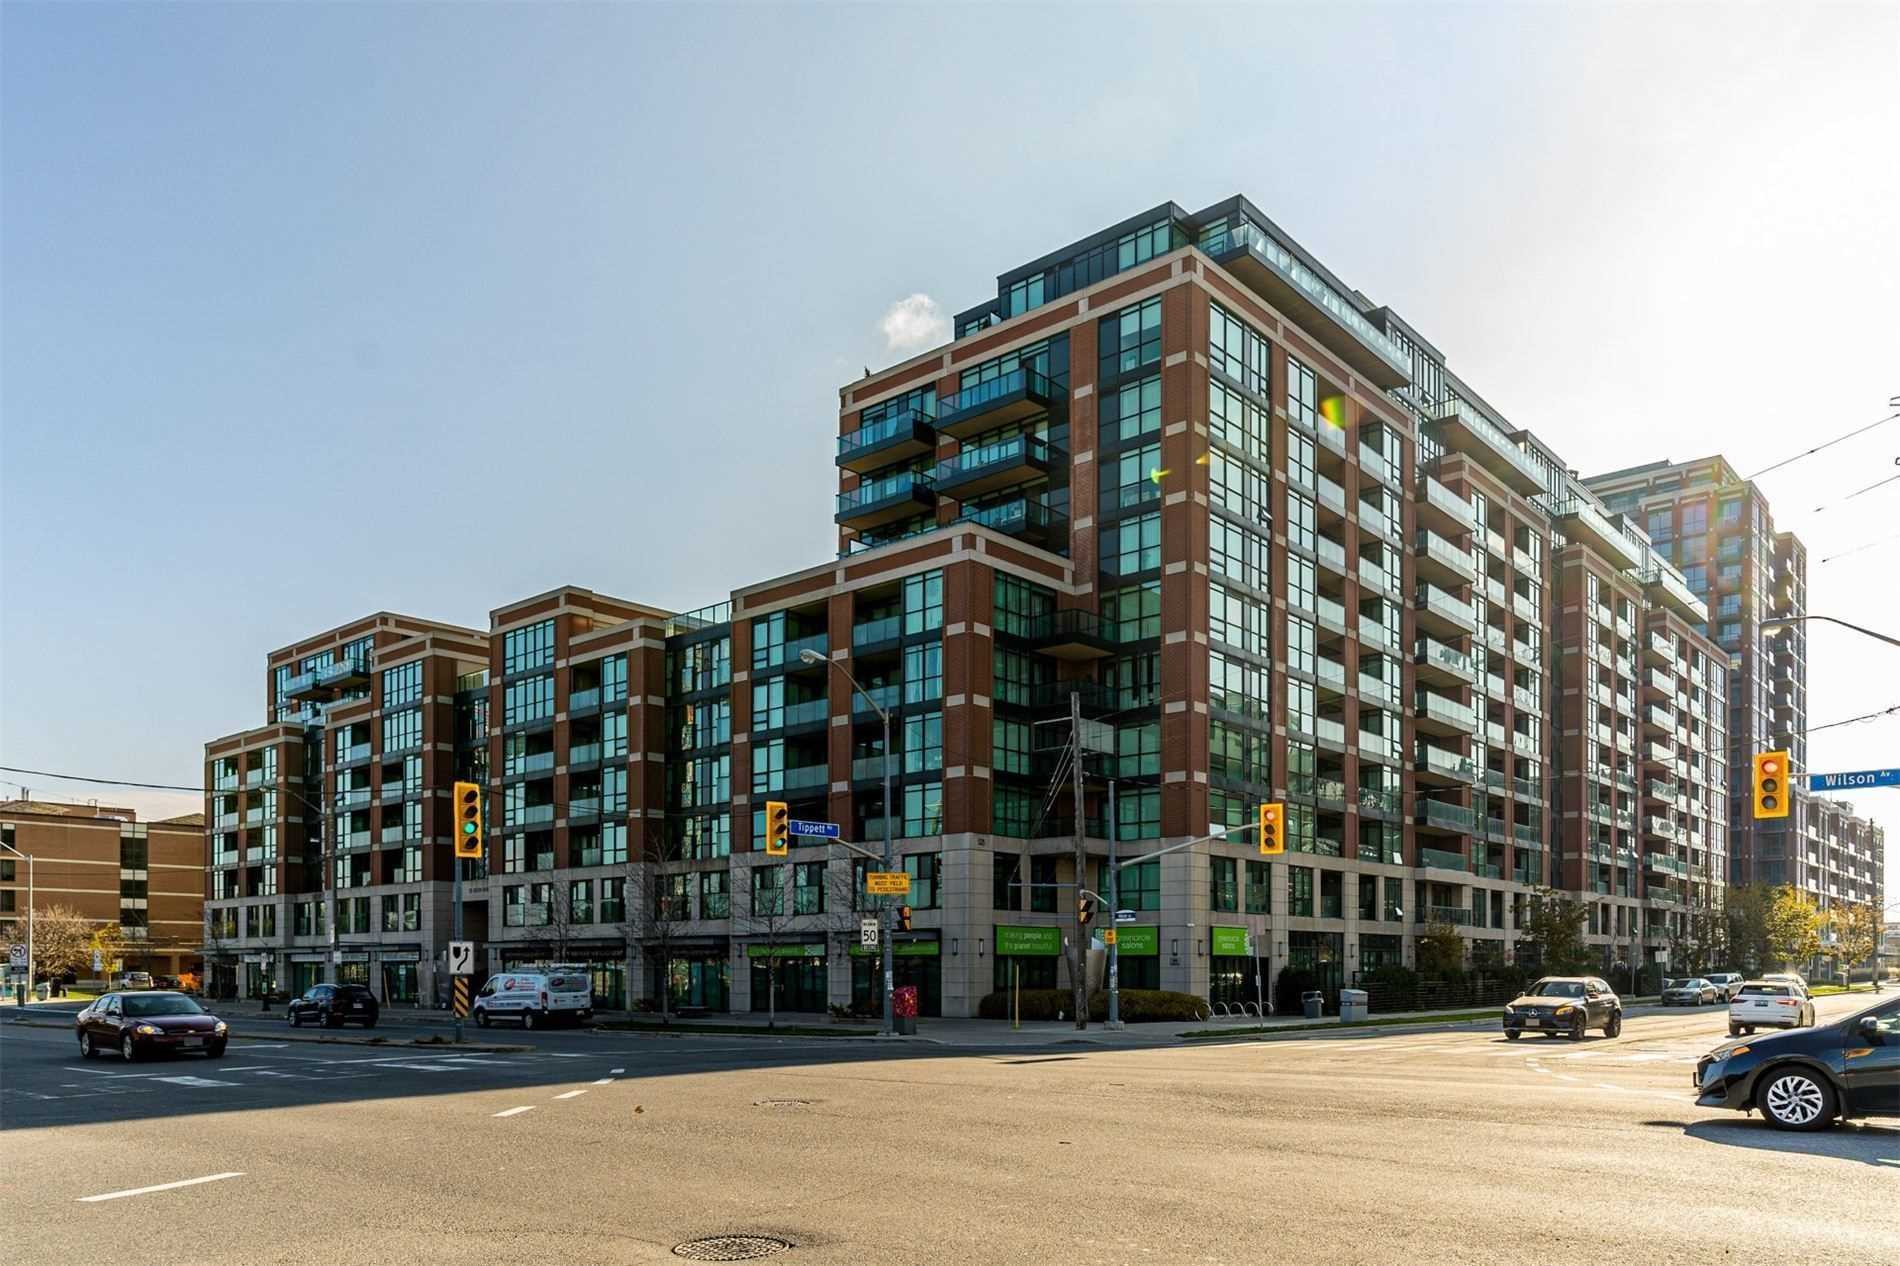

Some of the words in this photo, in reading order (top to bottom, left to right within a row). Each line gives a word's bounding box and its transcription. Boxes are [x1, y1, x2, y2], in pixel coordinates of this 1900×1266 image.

[1825, 773, 1875, 786] Wilson
[798, 822, 826, 834] Tippett
[863, 929, 877, 942] 50
